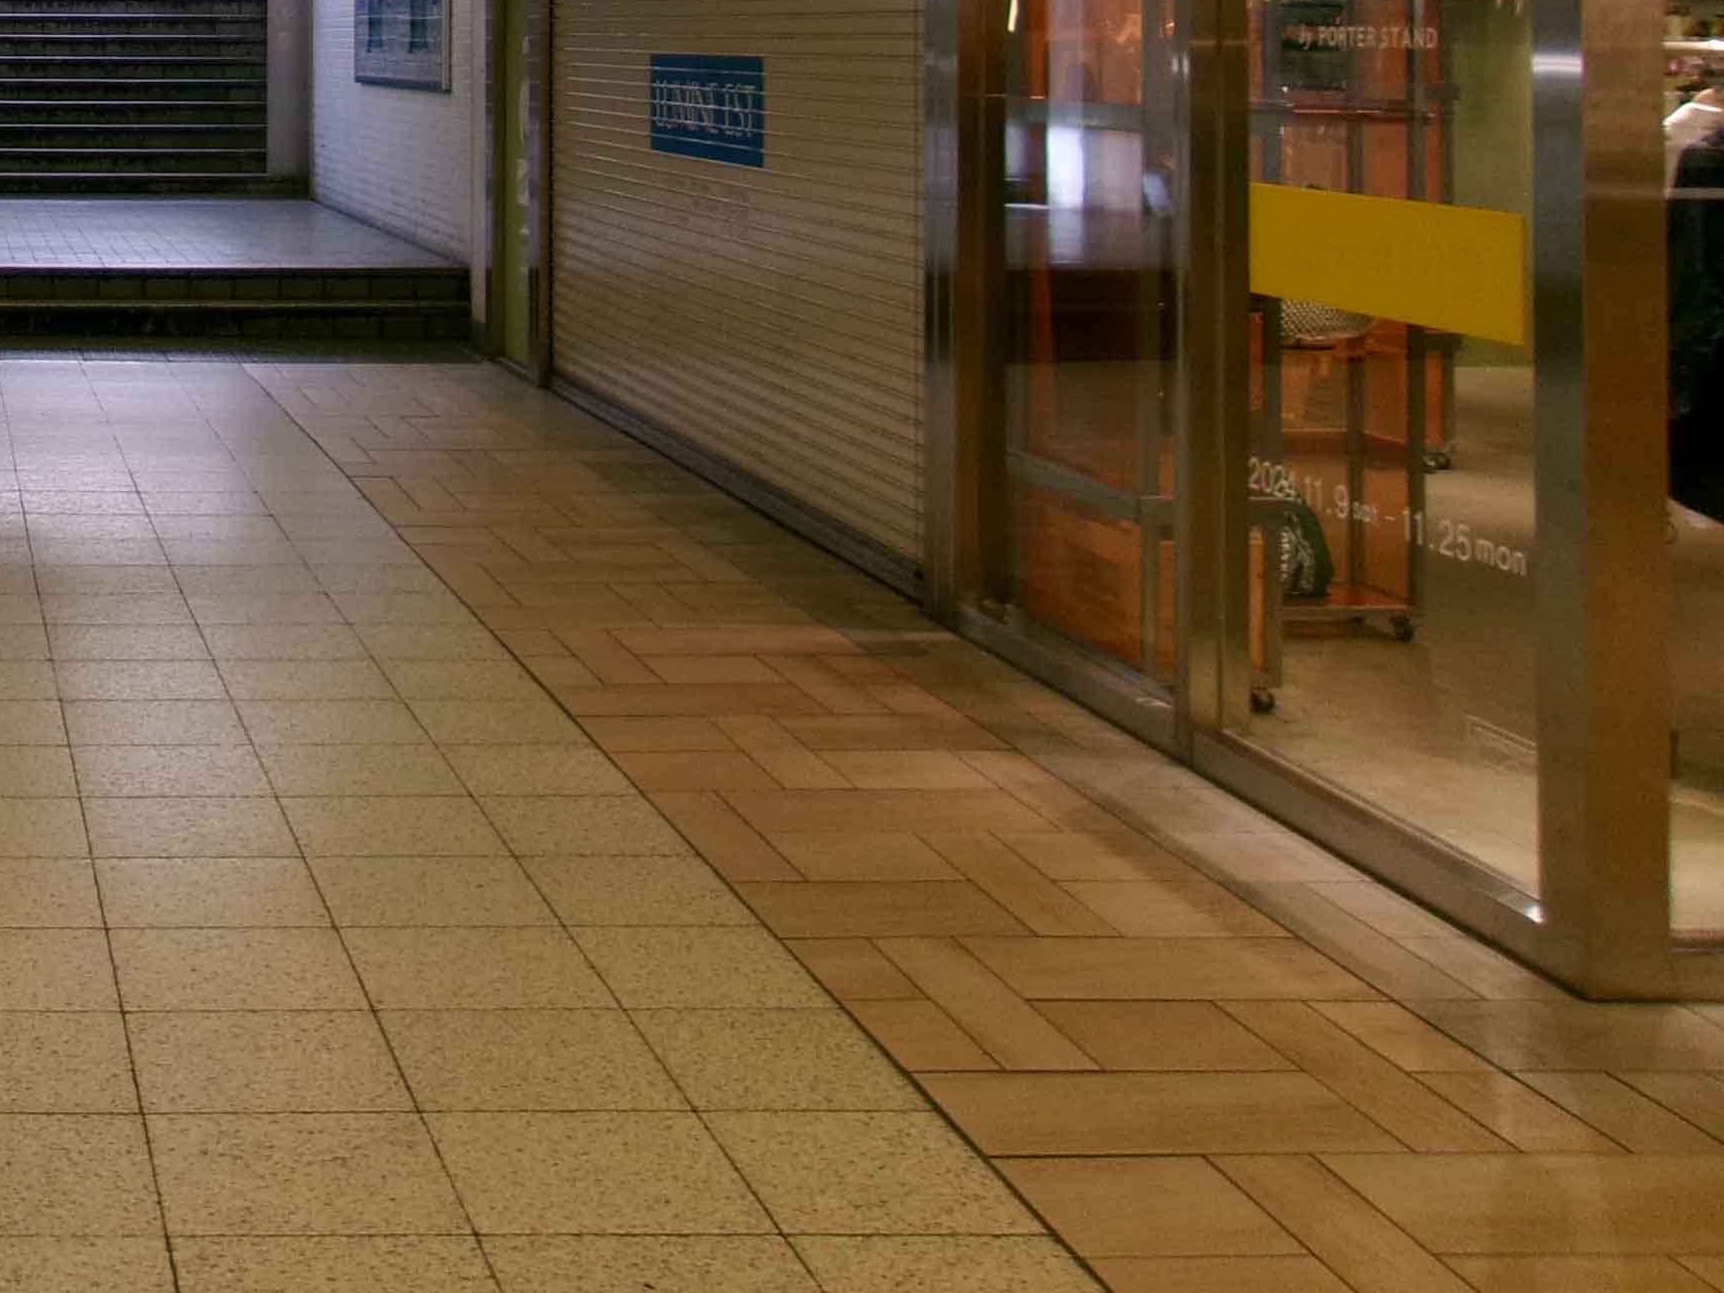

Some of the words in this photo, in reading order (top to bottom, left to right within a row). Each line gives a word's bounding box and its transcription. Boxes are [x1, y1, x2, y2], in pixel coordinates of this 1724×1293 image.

[1316, 26, 1376, 48] PORTER
[1379, 27, 1438, 49] STAND
[1475, 538, 1525, 576] mon
